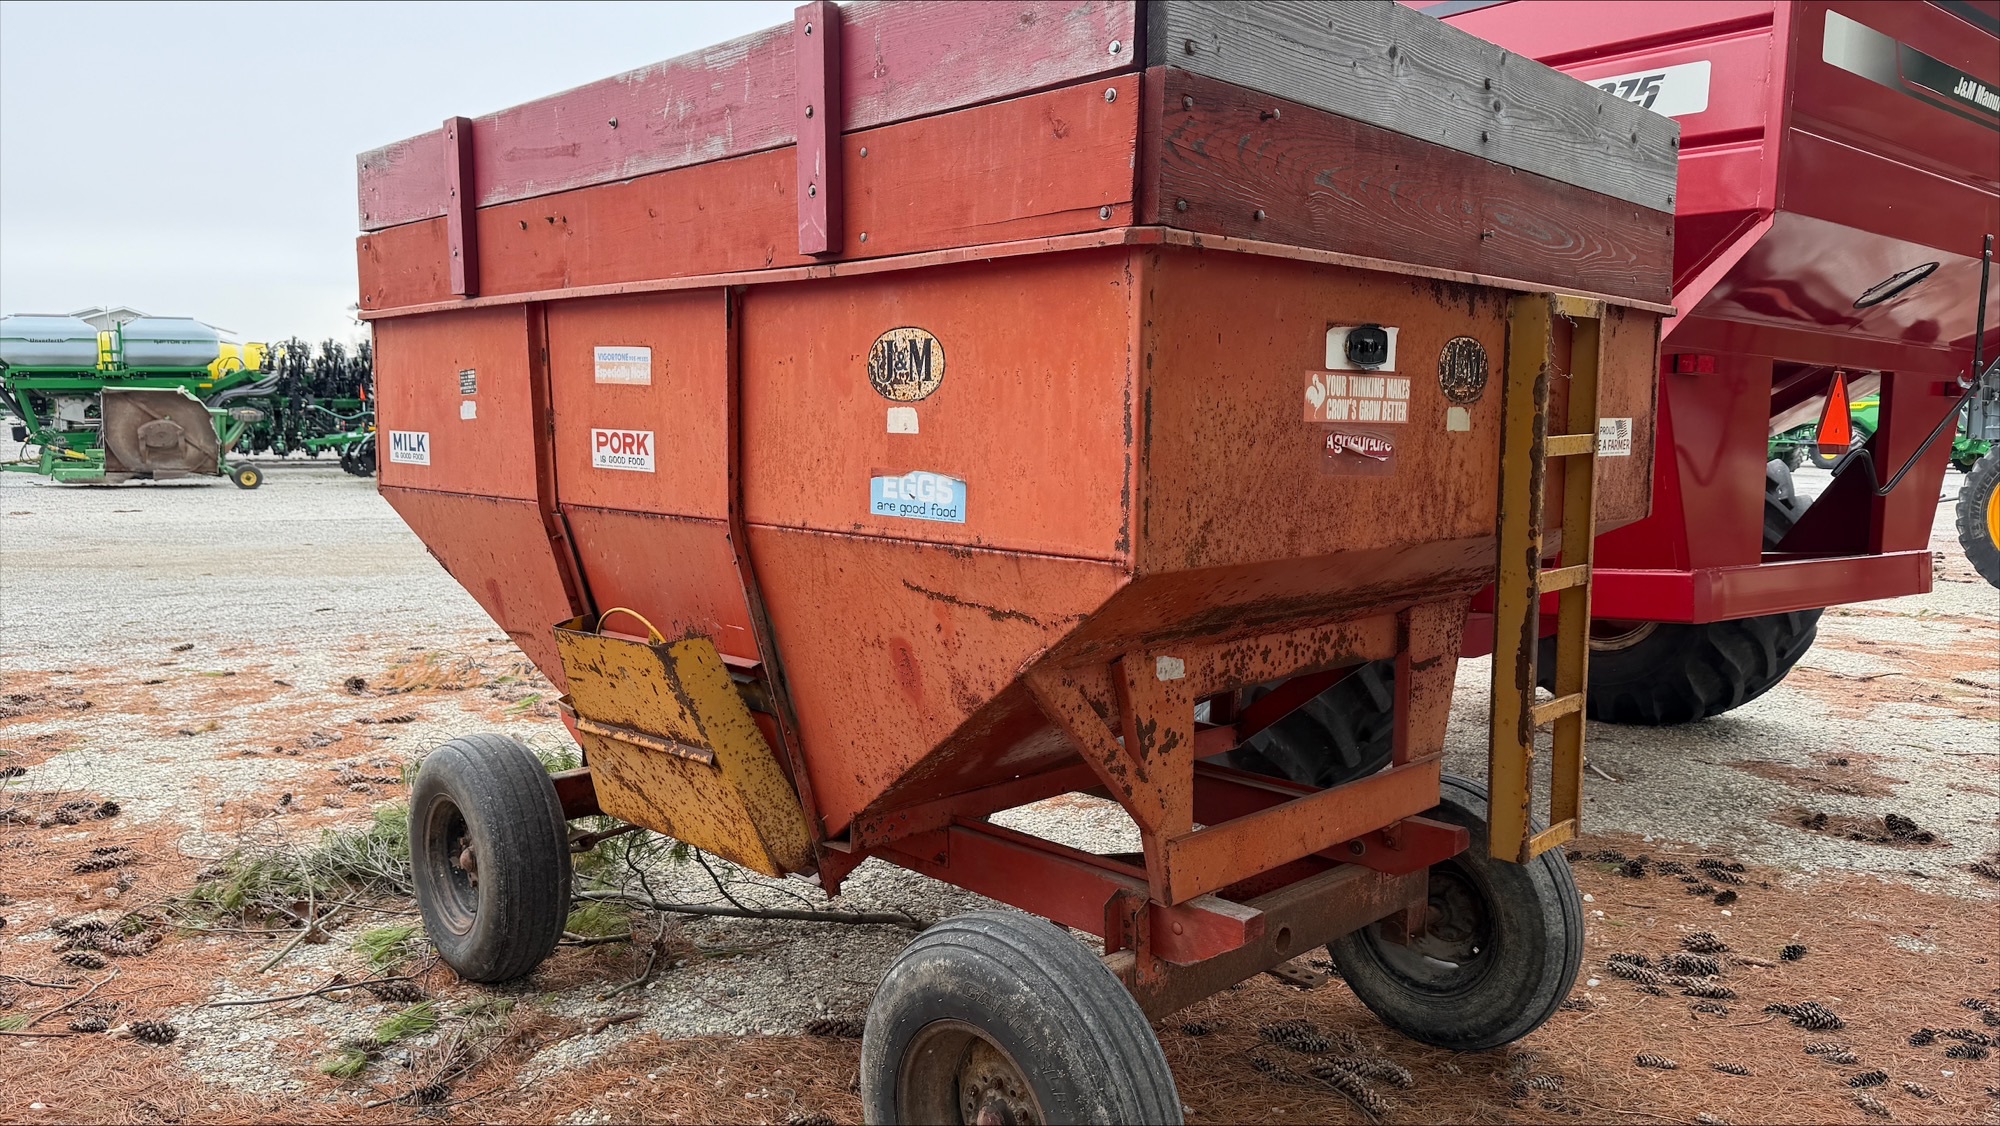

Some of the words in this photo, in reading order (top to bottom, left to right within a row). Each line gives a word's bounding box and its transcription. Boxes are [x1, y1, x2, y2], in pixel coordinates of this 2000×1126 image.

[1954, 76, 1977, 101] J&M
[1974, 84, 2000, 112] Manu
[877, 337, 934, 383] J&M
[1326, 374, 1347, 397] YOUR
[1348, 376, 1385, 399] THINKING
[1386, 378, 1411, 400] MAKES
[1326, 397, 1357, 421] CROW'S
[1359, 399, 1381, 421] GROW
[1382, 400, 1407, 422] BETTER
[1600, 426, 1616, 435] PROUD
[393, 432, 426, 453] MILK
[596, 431, 650, 456] PORK
[1602, 439, 1607, 451] A
[1607, 439, 1630, 451] FARMER
[400, 452, 412, 460] GOOD
[412, 453, 425, 461] FOOD
[600, 454, 607, 464] IS
[608, 455, 626, 465] GOOD
[628, 456, 646, 466] FOOD
[882, 473, 954, 505] EGGS
[877, 501, 896, 512] are
[899, 502, 926, 517] good
[931, 503, 957, 518] food
